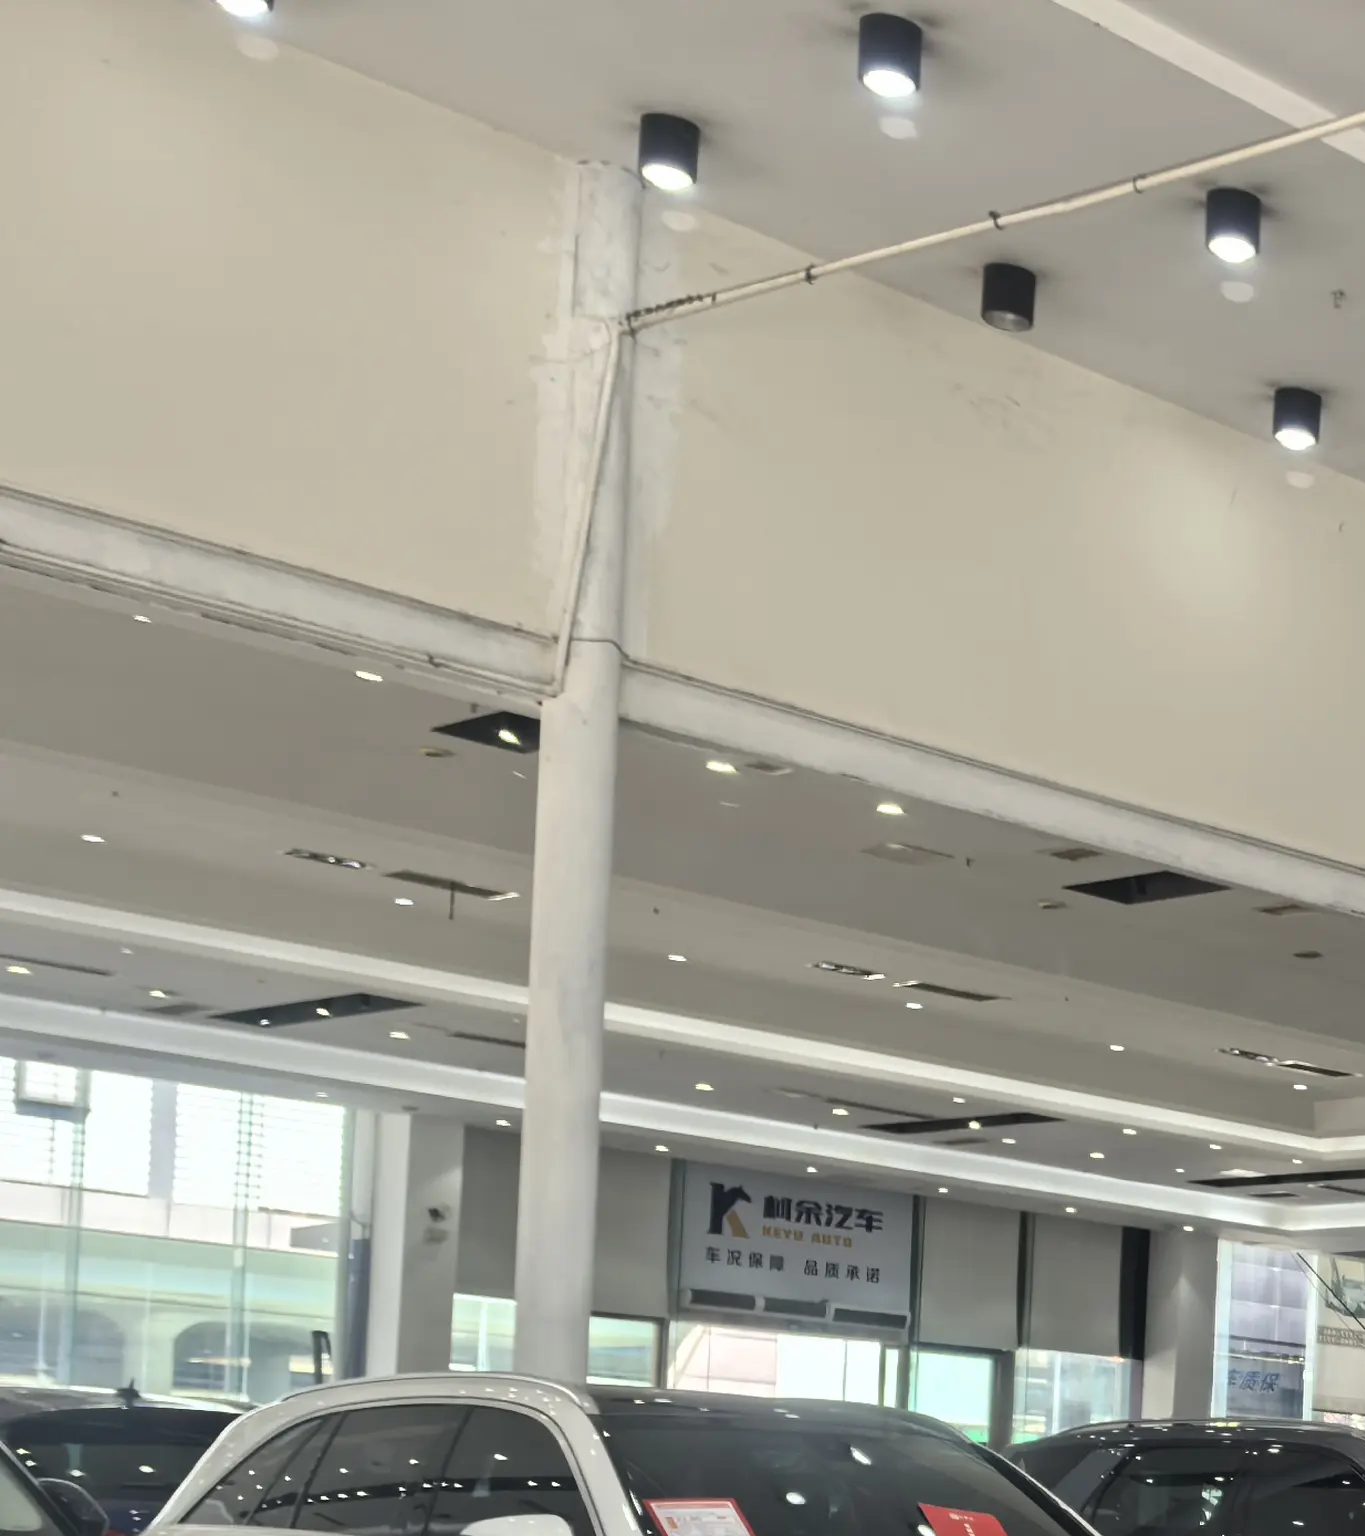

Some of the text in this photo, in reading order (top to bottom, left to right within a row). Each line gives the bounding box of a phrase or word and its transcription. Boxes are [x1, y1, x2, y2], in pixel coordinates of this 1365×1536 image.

[762, 1194, 884, 1234] 柯余汽车
[761, 1223, 854, 1248] KEYU AUTO
[705, 1246, 881, 1285] 车况保障 品质承诺
